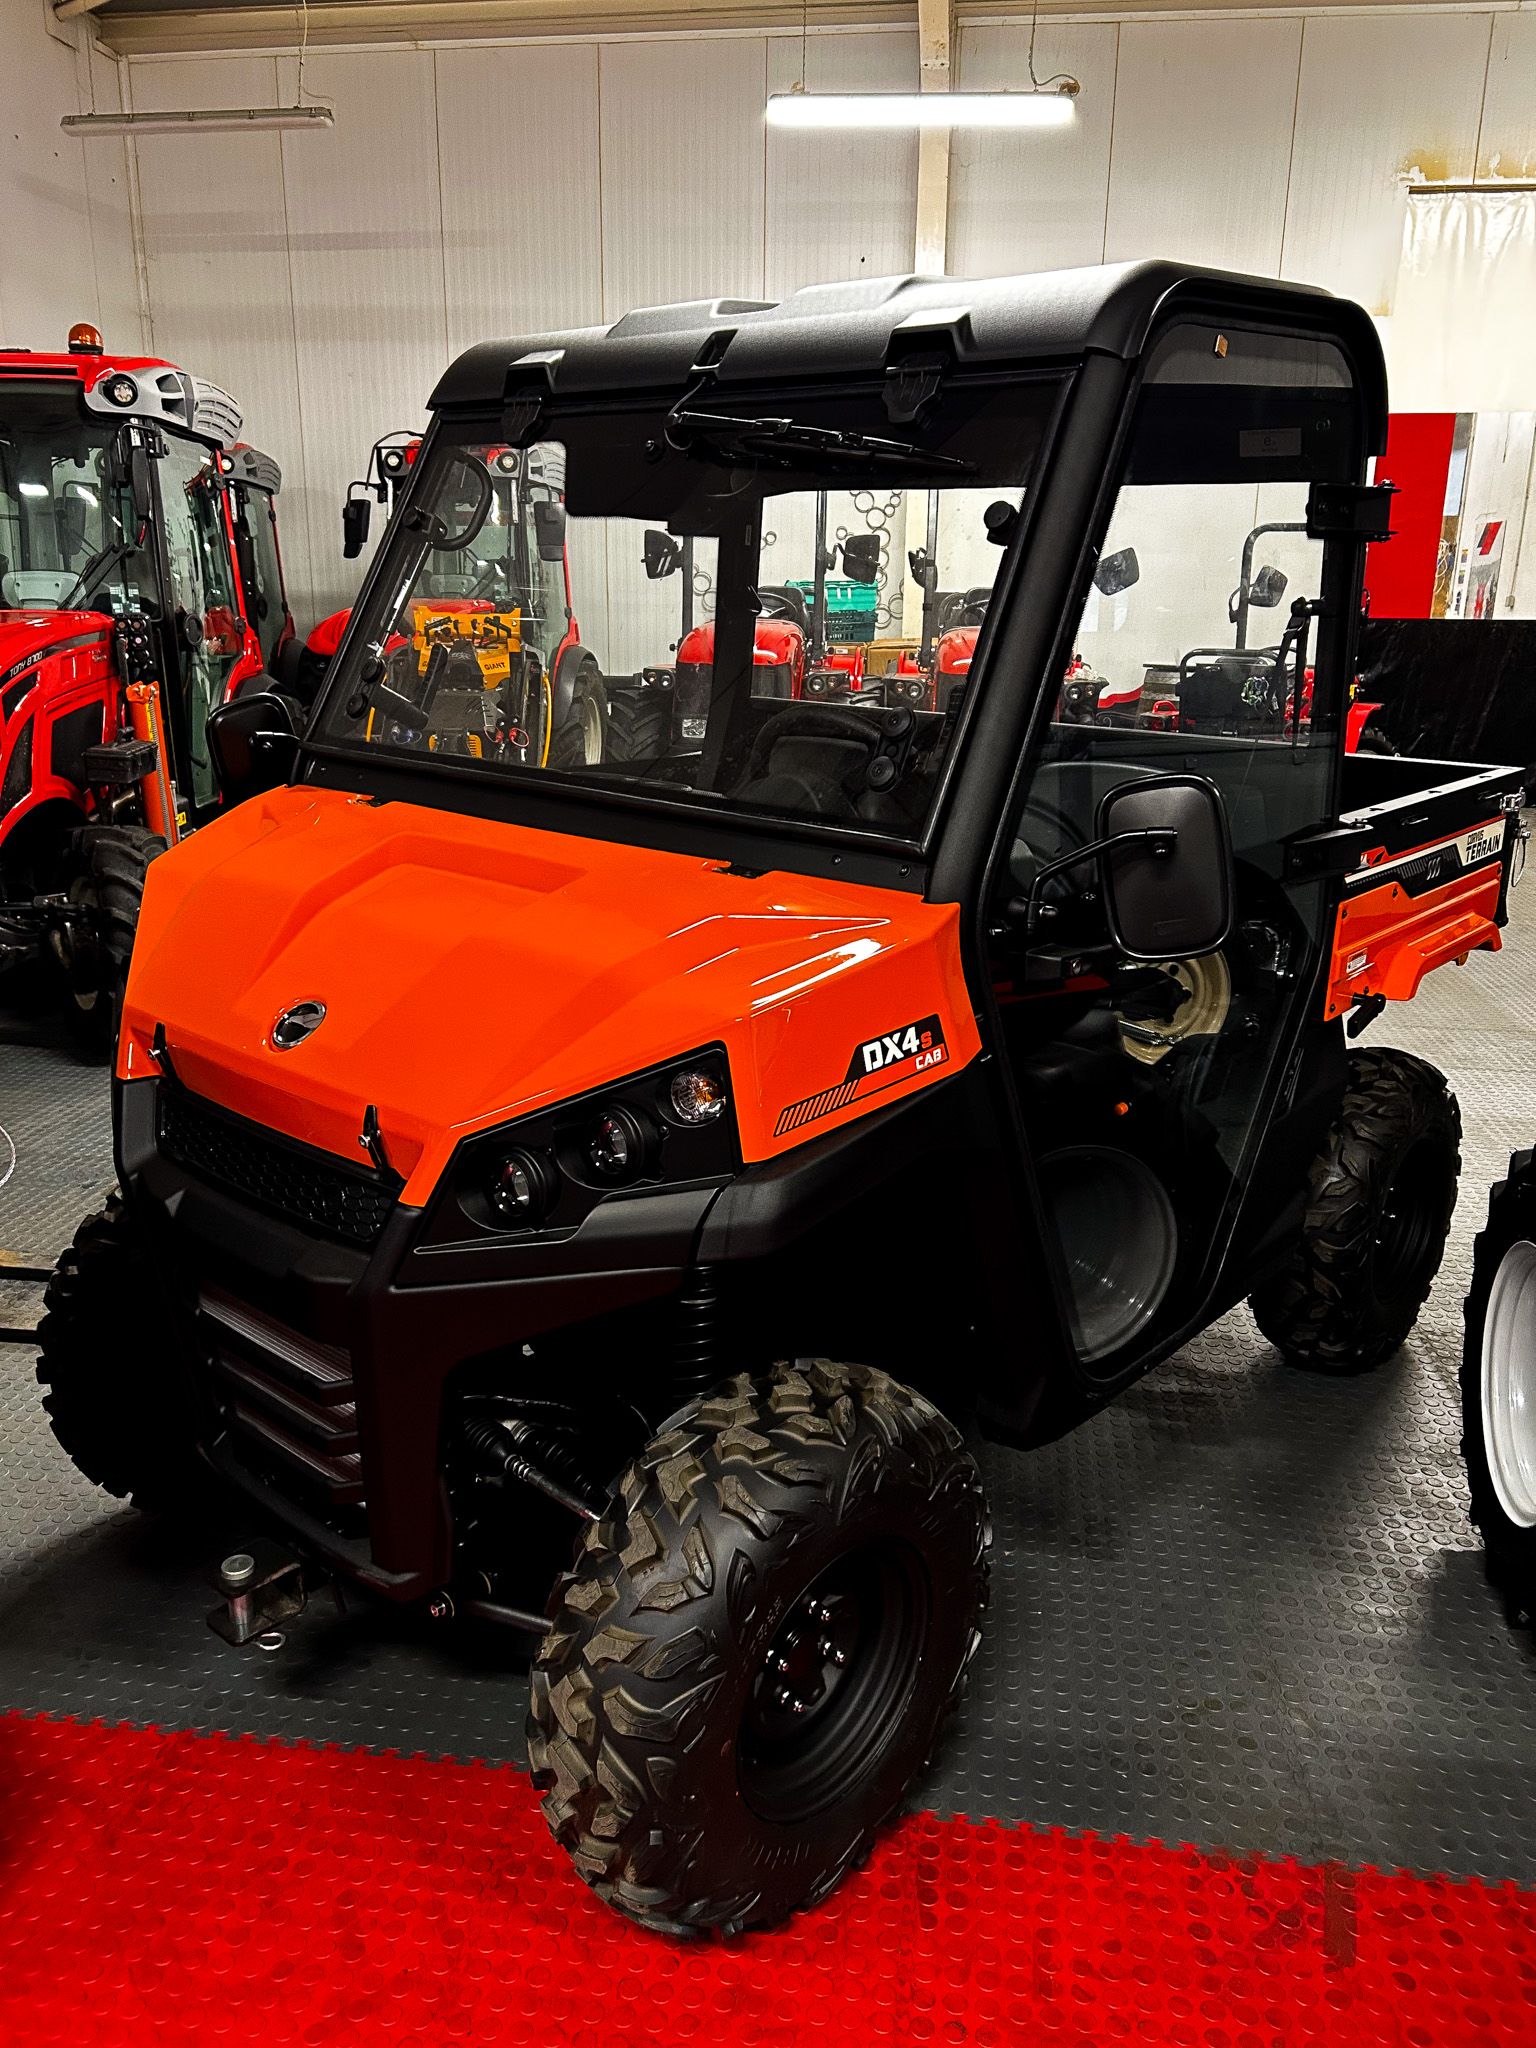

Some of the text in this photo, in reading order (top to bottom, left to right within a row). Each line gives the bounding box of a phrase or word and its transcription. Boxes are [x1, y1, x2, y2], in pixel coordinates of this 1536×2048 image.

[10, 651, 43, 678] TONY 8700
[484, 662, 505, 670] GIANT
[1466, 834, 1501, 862] TERRAIN
[915, 1048, 942, 1070] CAB
